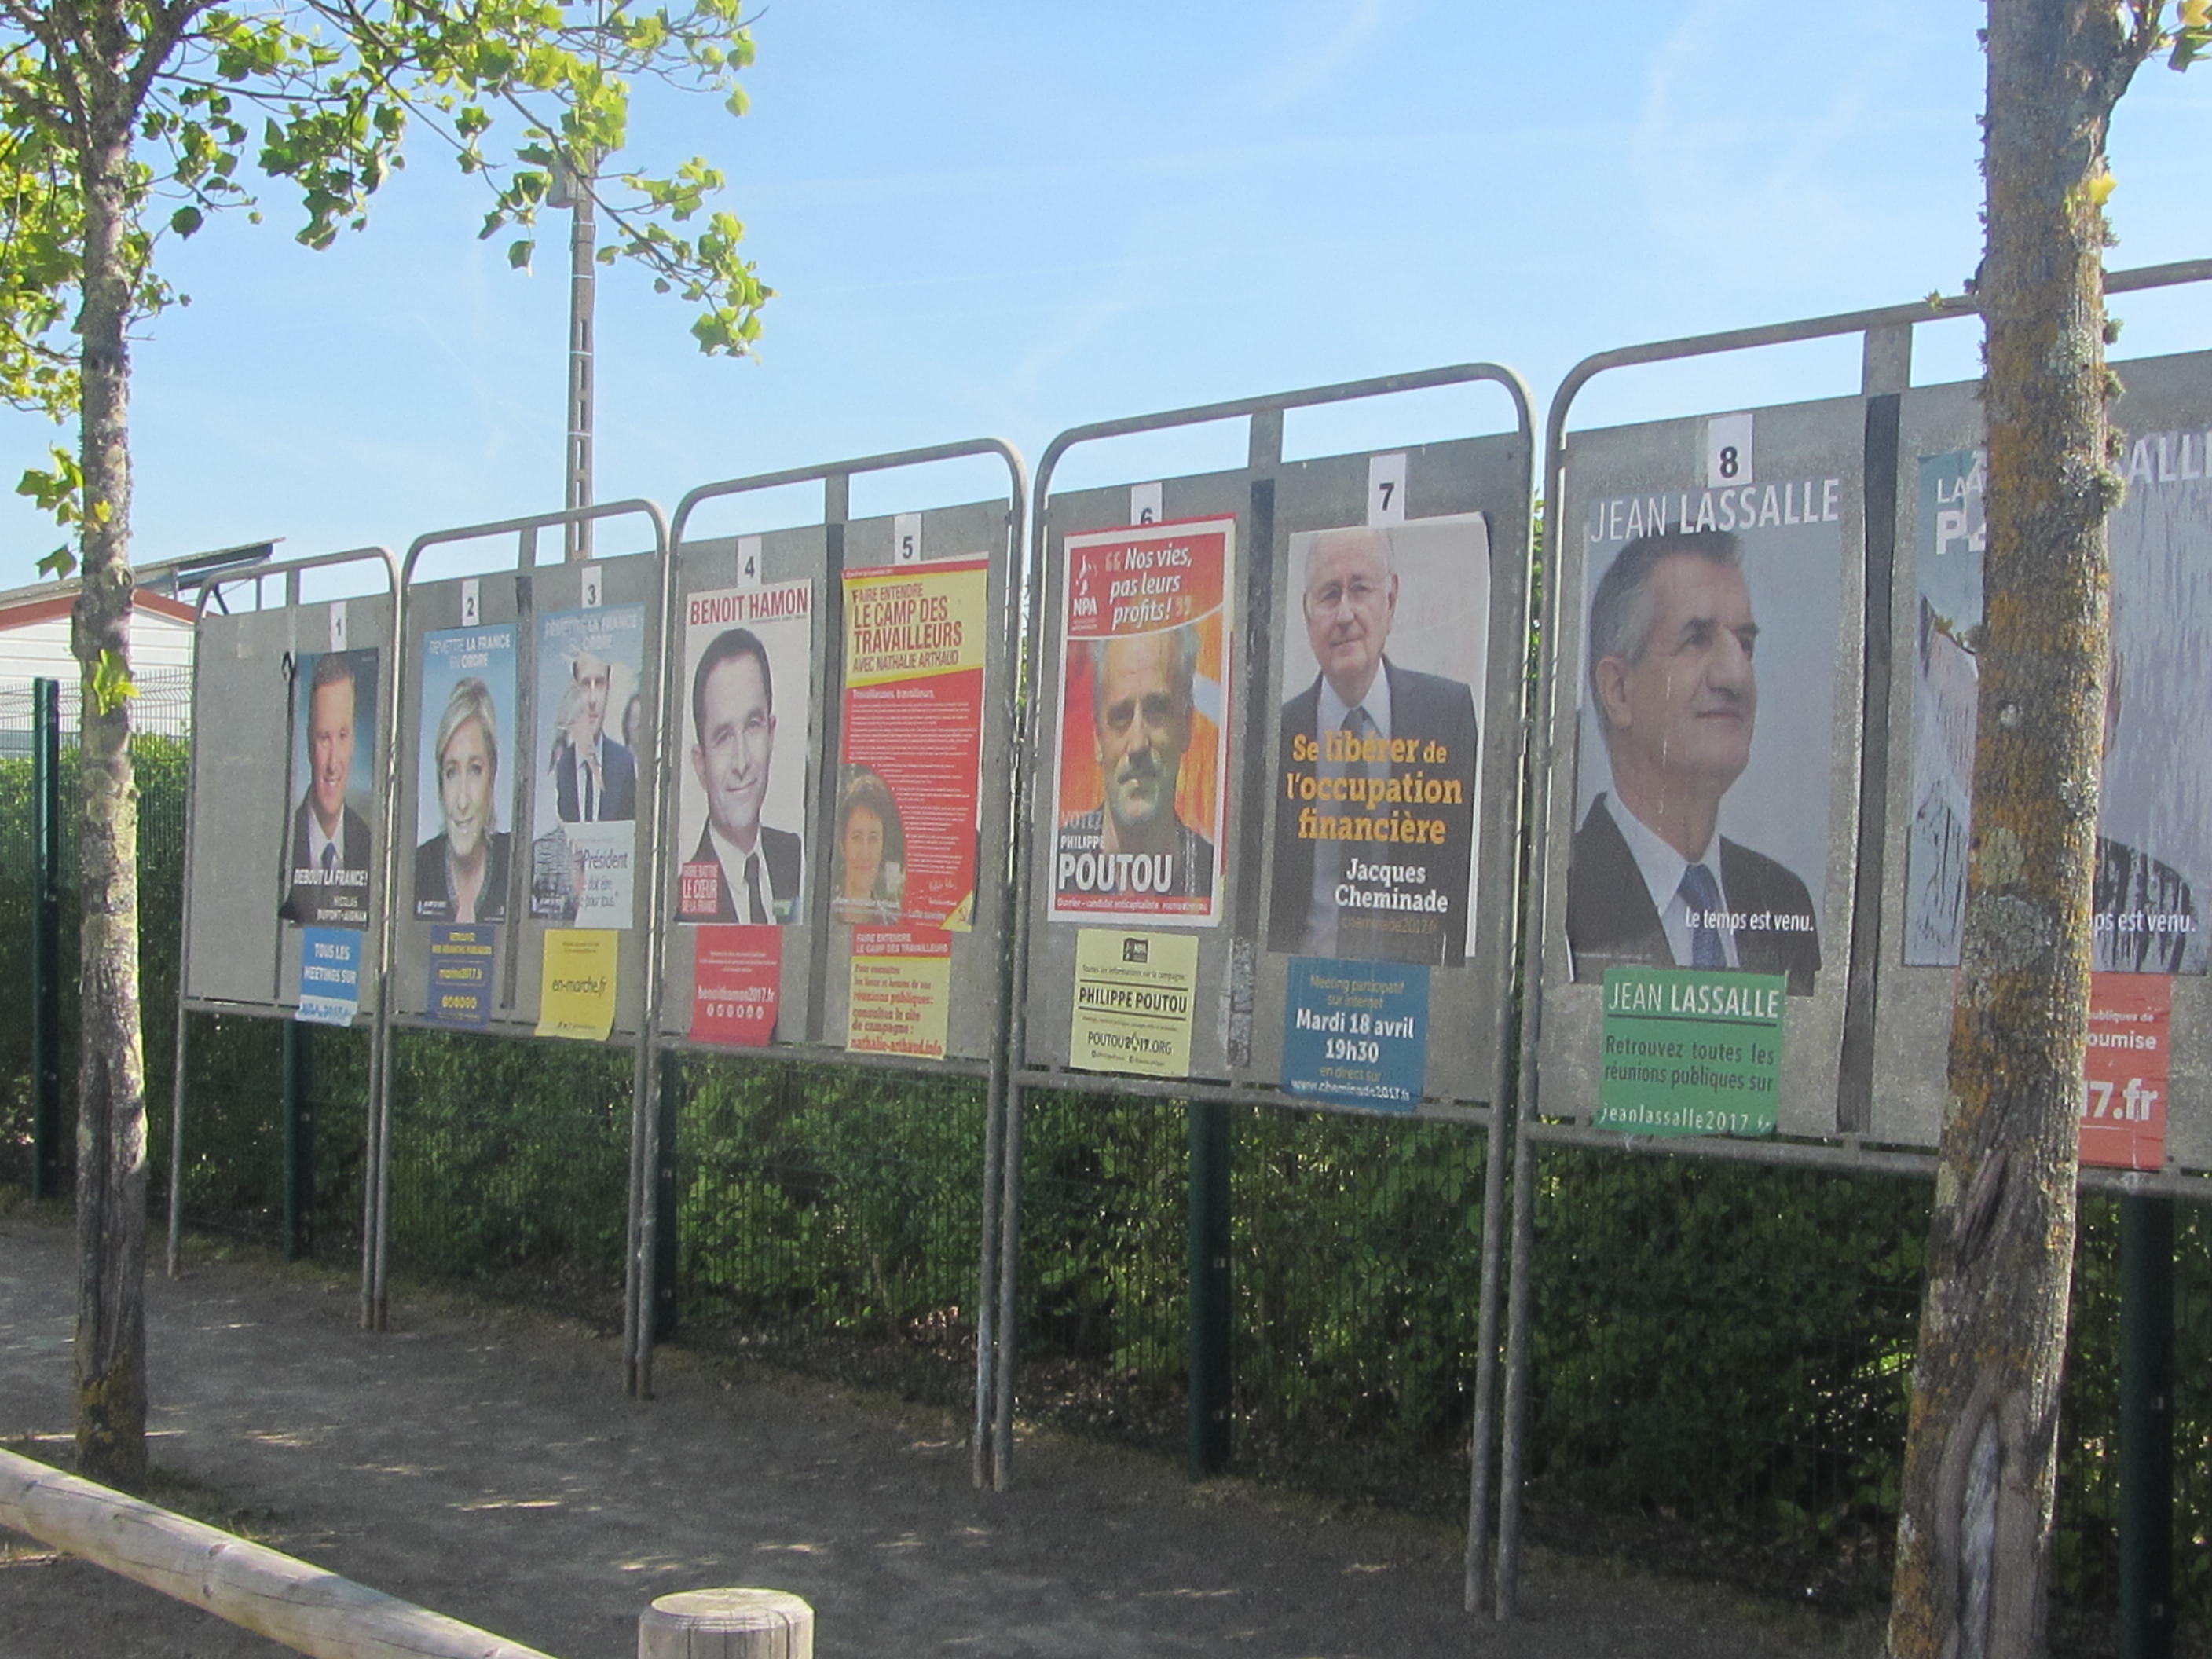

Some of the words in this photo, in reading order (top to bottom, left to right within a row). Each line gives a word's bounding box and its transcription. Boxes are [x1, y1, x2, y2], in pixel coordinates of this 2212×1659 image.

[1719, 446, 1738, 478] 8
[1379, 482, 1395, 511] 7
[1140, 507, 1153, 524] 6
[1591, 494, 1667, 544] JEAN
[1679, 478, 1840, 535] LASSALLE
[903, 535, 913, 558] 5
[1124, 547, 1153, 571] Nos
[1157, 542, 1193, 569] vies,
[744, 556, 755, 578] 4
[588, 584, 596, 605] 3
[852, 588, 878, 604] FAIRE
[880, 583, 923, 602] ENTENDRE
[1109, 579, 1138, 604] pas
[1141, 572, 1181, 596] leurs
[467, 597, 475, 617] 2
[690, 595, 745, 626] BENOIT
[749, 588, 808, 619] HAMON
[855, 604, 870, 628] LE
[874, 599, 917, 627] CAMP
[920, 596, 947, 623] DES
[1073, 596, 1098, 617] NPA
[335, 618, 342, 637] 1
[854, 621, 962, 655] TRAVAILLEURS
[466, 637, 476, 652] LA
[477, 633, 511, 650] FRANCE
[852, 656, 874, 673] AVEC
[876, 653, 917, 672] NATHALIE
[918, 650, 958, 668] ARTHAUD
[1292, 733, 1320, 763] Se
[1325, 729, 1421, 764] libérer
[1423, 741, 1448, 764] de
[1286, 770, 1464, 811] l'occupation
[1061, 810, 1102, 830] VOTEZ
[1298, 807, 1447, 844] financière
[1060, 834, 1104, 850] PHILIPPE
[294, 869, 323, 885] DEBOUT
[324, 870, 335, 886] LA
[1058, 852, 1174, 893] POUTOU
[1346, 857, 1426, 888] Jacques
[683, 879, 692, 899] LE
[1335, 884, 1449, 913] Cheminade
[1685, 906, 1700, 930] Le
[1703, 910, 1747, 936] temps
[1749, 910, 1771, 932] est
[1774, 914, 1815, 932] venu.
[2118, 910, 2144, 932] est
[2148, 914, 2196, 932] venu.
[856, 932, 875, 943] FAIRE
[877, 932, 911, 943] ENTENDRE
[856, 943, 864, 954] LE
[866, 943, 885, 954] CAMP
[887, 943, 900, 954] DES
[902, 943, 948, 954] TRAVAILLEURS
[314, 943, 335, 959] TOUS
[335, 945, 350, 961] LES
[303, 966, 341, 983] MEETINGS
[342, 971, 357, 984] SUR
[1309, 974, 1350, 994] Meeting
[1079, 987, 1133, 1008] PHILIPPE
[1136, 992, 1188, 1014] POUTOU
[1328, 994, 1343, 1006] sur
[1608, 981, 1662, 1012] JEAN
[1670, 983, 1779, 1019] LASSALLE
[1296, 1007, 1346, 1033] Mardi
[1349, 1013, 1371, 1035] 18
[1374, 1016, 1415, 1039] avril
[2089, 1009, 2137, 1023] ubliques
[2140, 1013, 2154, 1023] de
[851, 1020, 863, 1031] de
[864, 1023, 910, 1036] campagne
[2086, 1029, 2157, 1050] oumise
[1088, 1030, 1173, 1055] POUTOU2017.ORG
[1325, 1037, 1380, 1064] 19h30
[1606, 1035, 1684, 1060] Retrouvez
[1691, 1040, 1742, 1064] toutes
[1751, 1042, 1774, 1066] les
[1320, 1065, 1335, 1078] en
[1335, 1065, 1364, 1081] direct
[1604, 1061, 1667, 1084] réunions
[1671, 1063, 1745, 1093] publiques
[1749, 1074, 1773, 1093] sur
[1291, 1078, 1411, 1101] www.cheminade2017.fr
[2082, 1077, 2159, 1121] 17.fr
